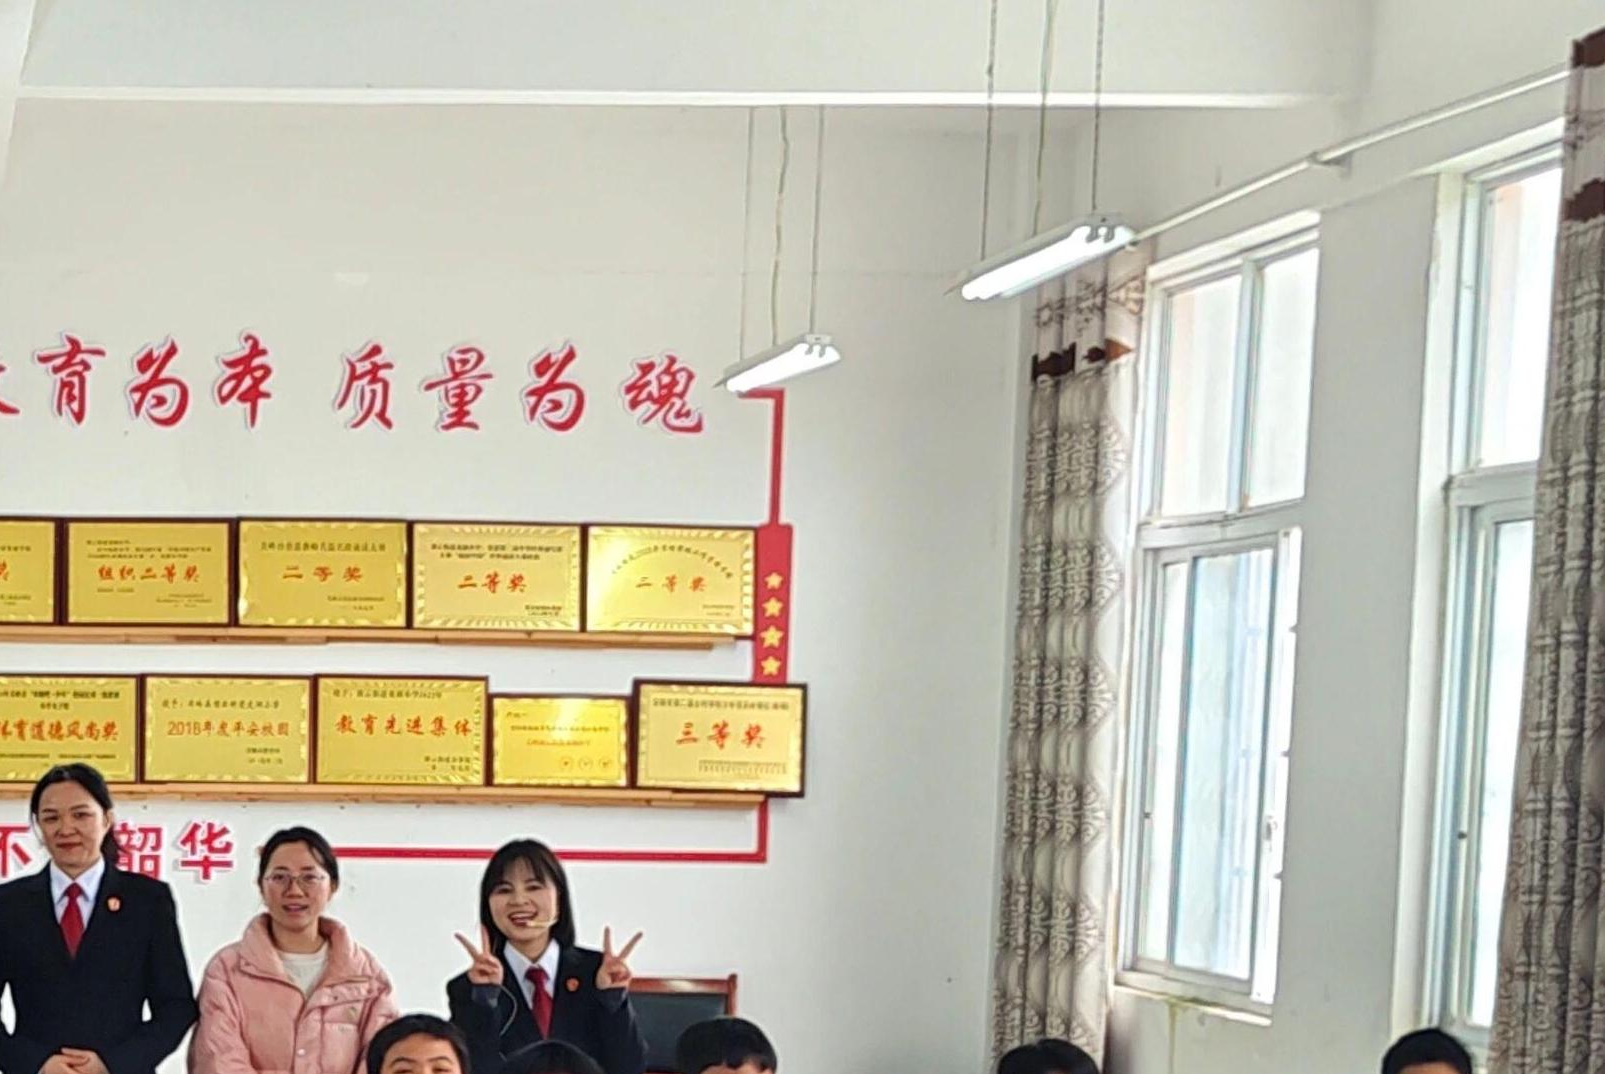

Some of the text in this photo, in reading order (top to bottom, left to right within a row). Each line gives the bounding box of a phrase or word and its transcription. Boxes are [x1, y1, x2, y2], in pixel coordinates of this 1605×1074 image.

[335, 343, 706, 436] 质量为魂
[98, 563, 200, 583] 组织二等奖
[458, 571, 526, 593] 二等奖
[167, 720, 290, 737] 2018年度平安校园
[335, 714, 472, 737] 教育先进集体
[676, 720, 766, 750] 三等奖
